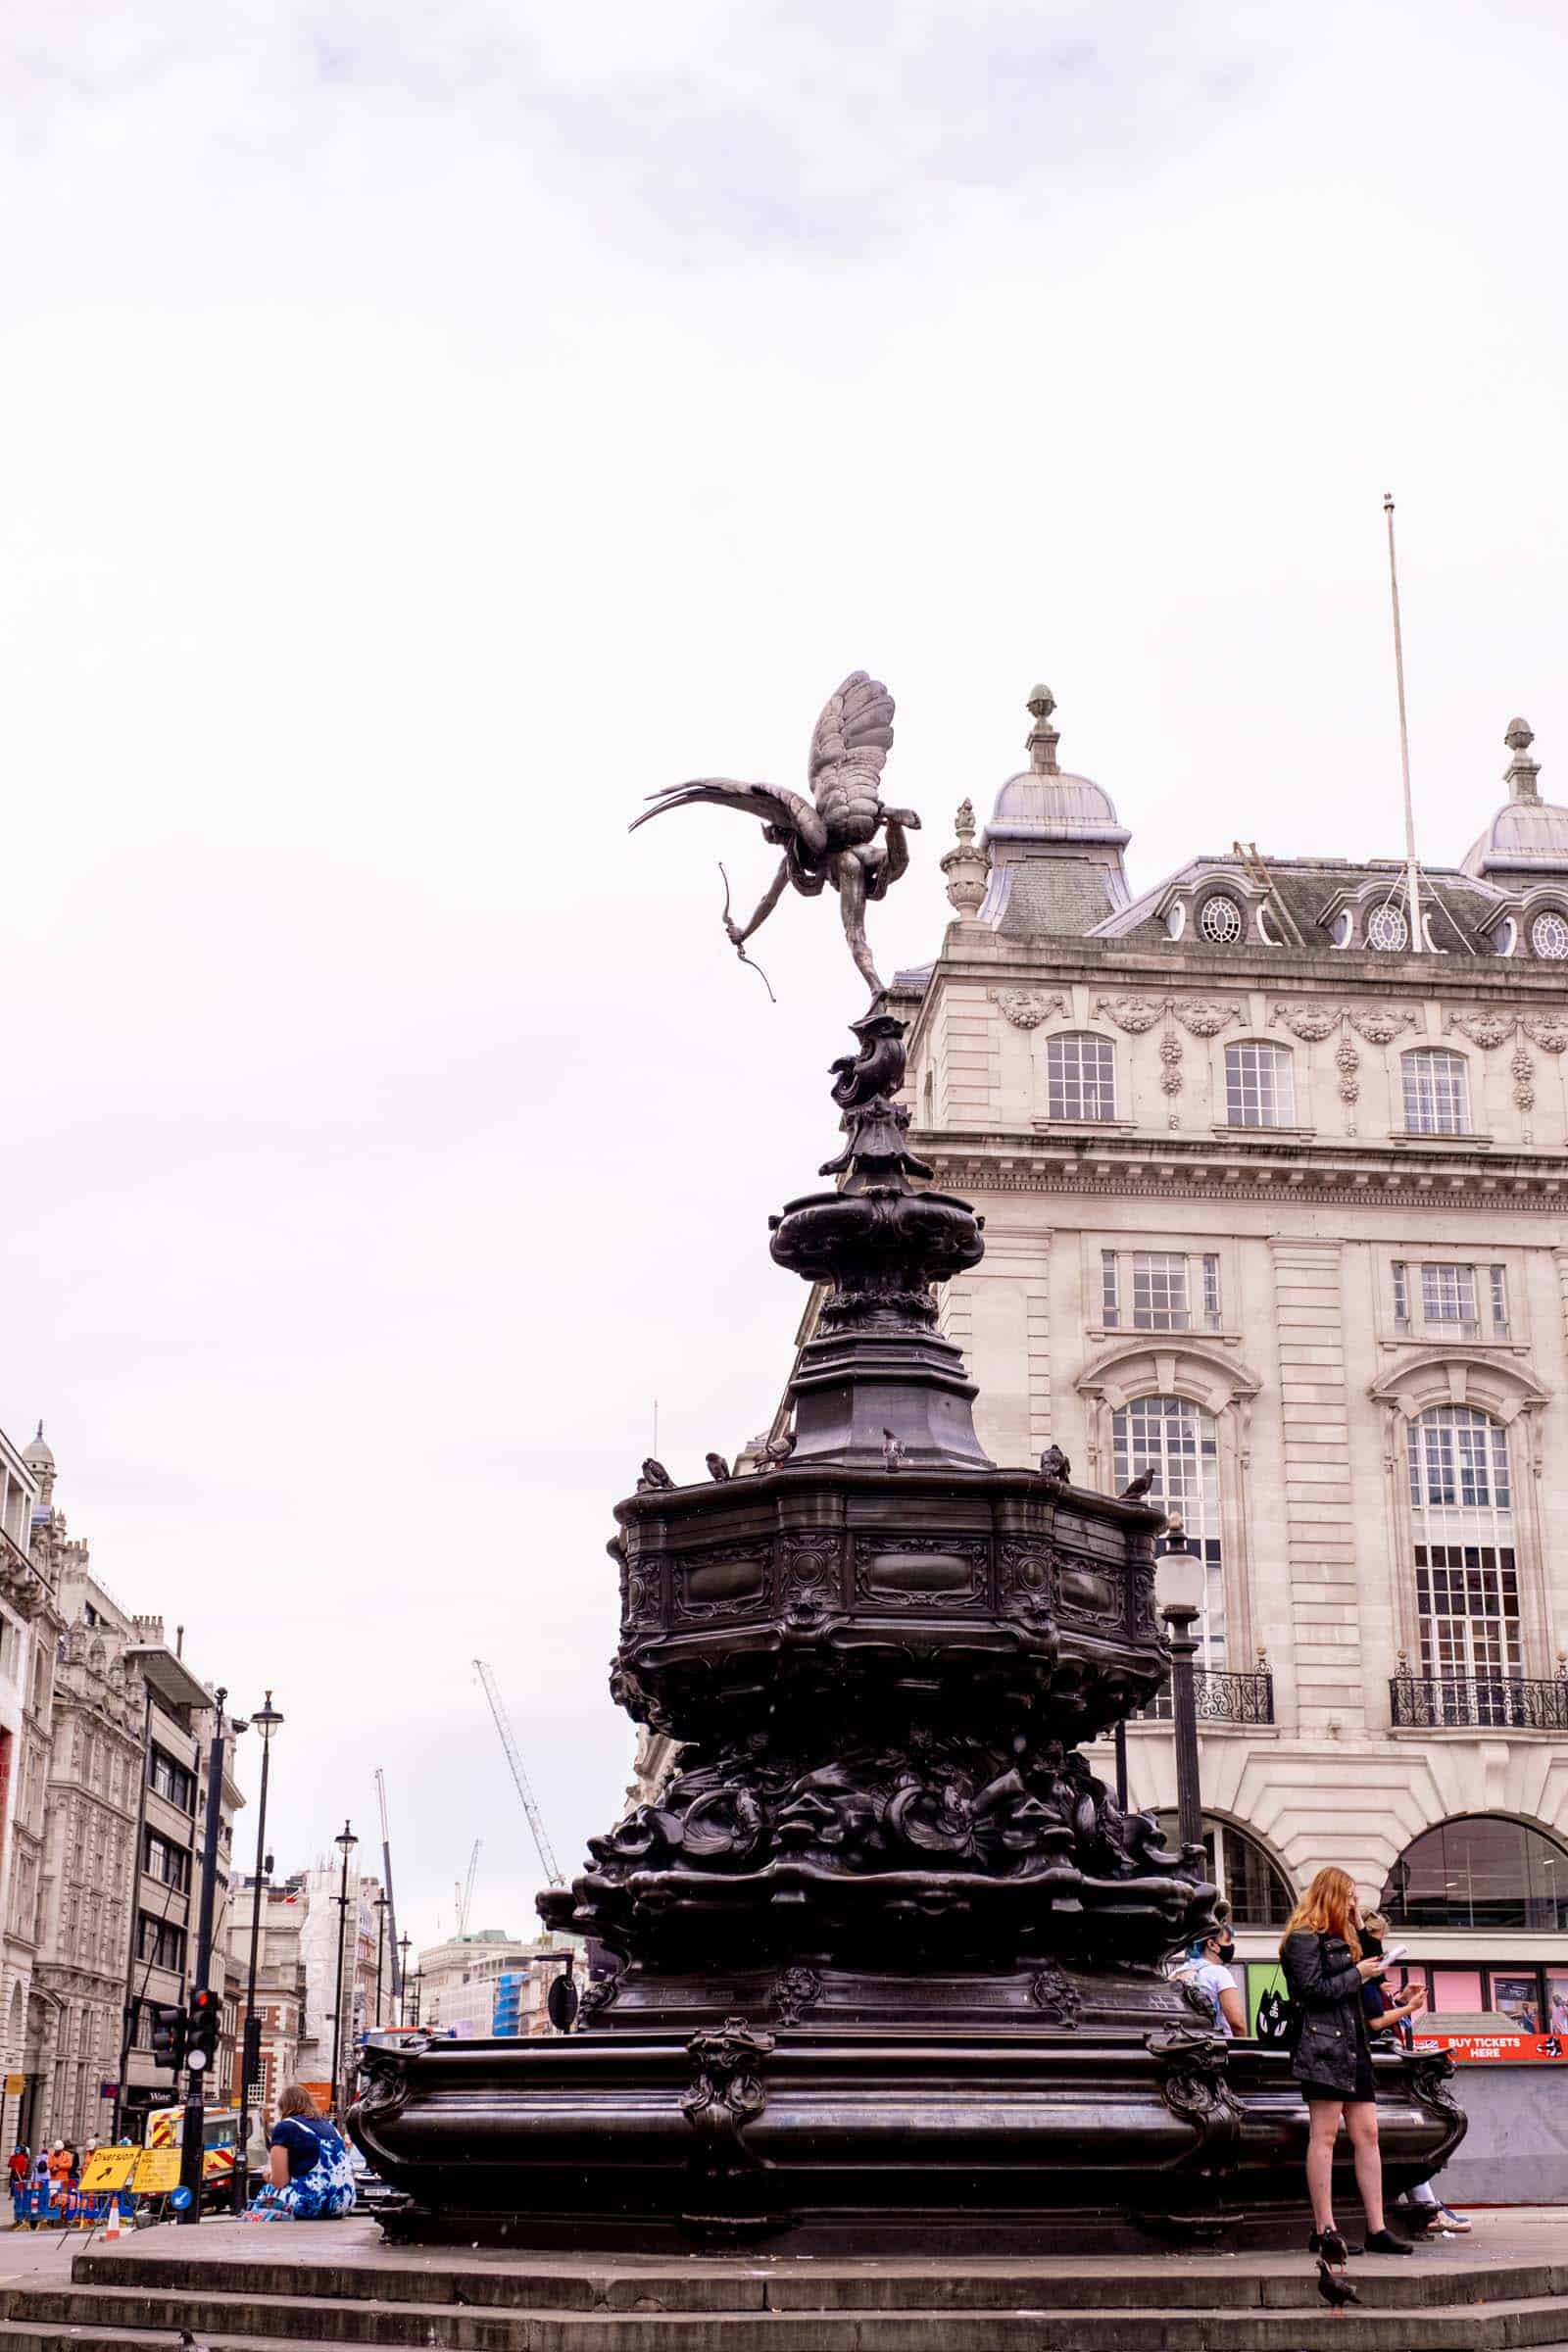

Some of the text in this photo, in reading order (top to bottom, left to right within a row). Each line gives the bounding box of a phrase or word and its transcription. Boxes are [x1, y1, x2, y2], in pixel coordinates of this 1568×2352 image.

[1448, 2038, 1471, 2047] BUY
[1474, 2037, 1521, 2047] TICKETS
[1471, 2048, 1500, 2058] HERE
